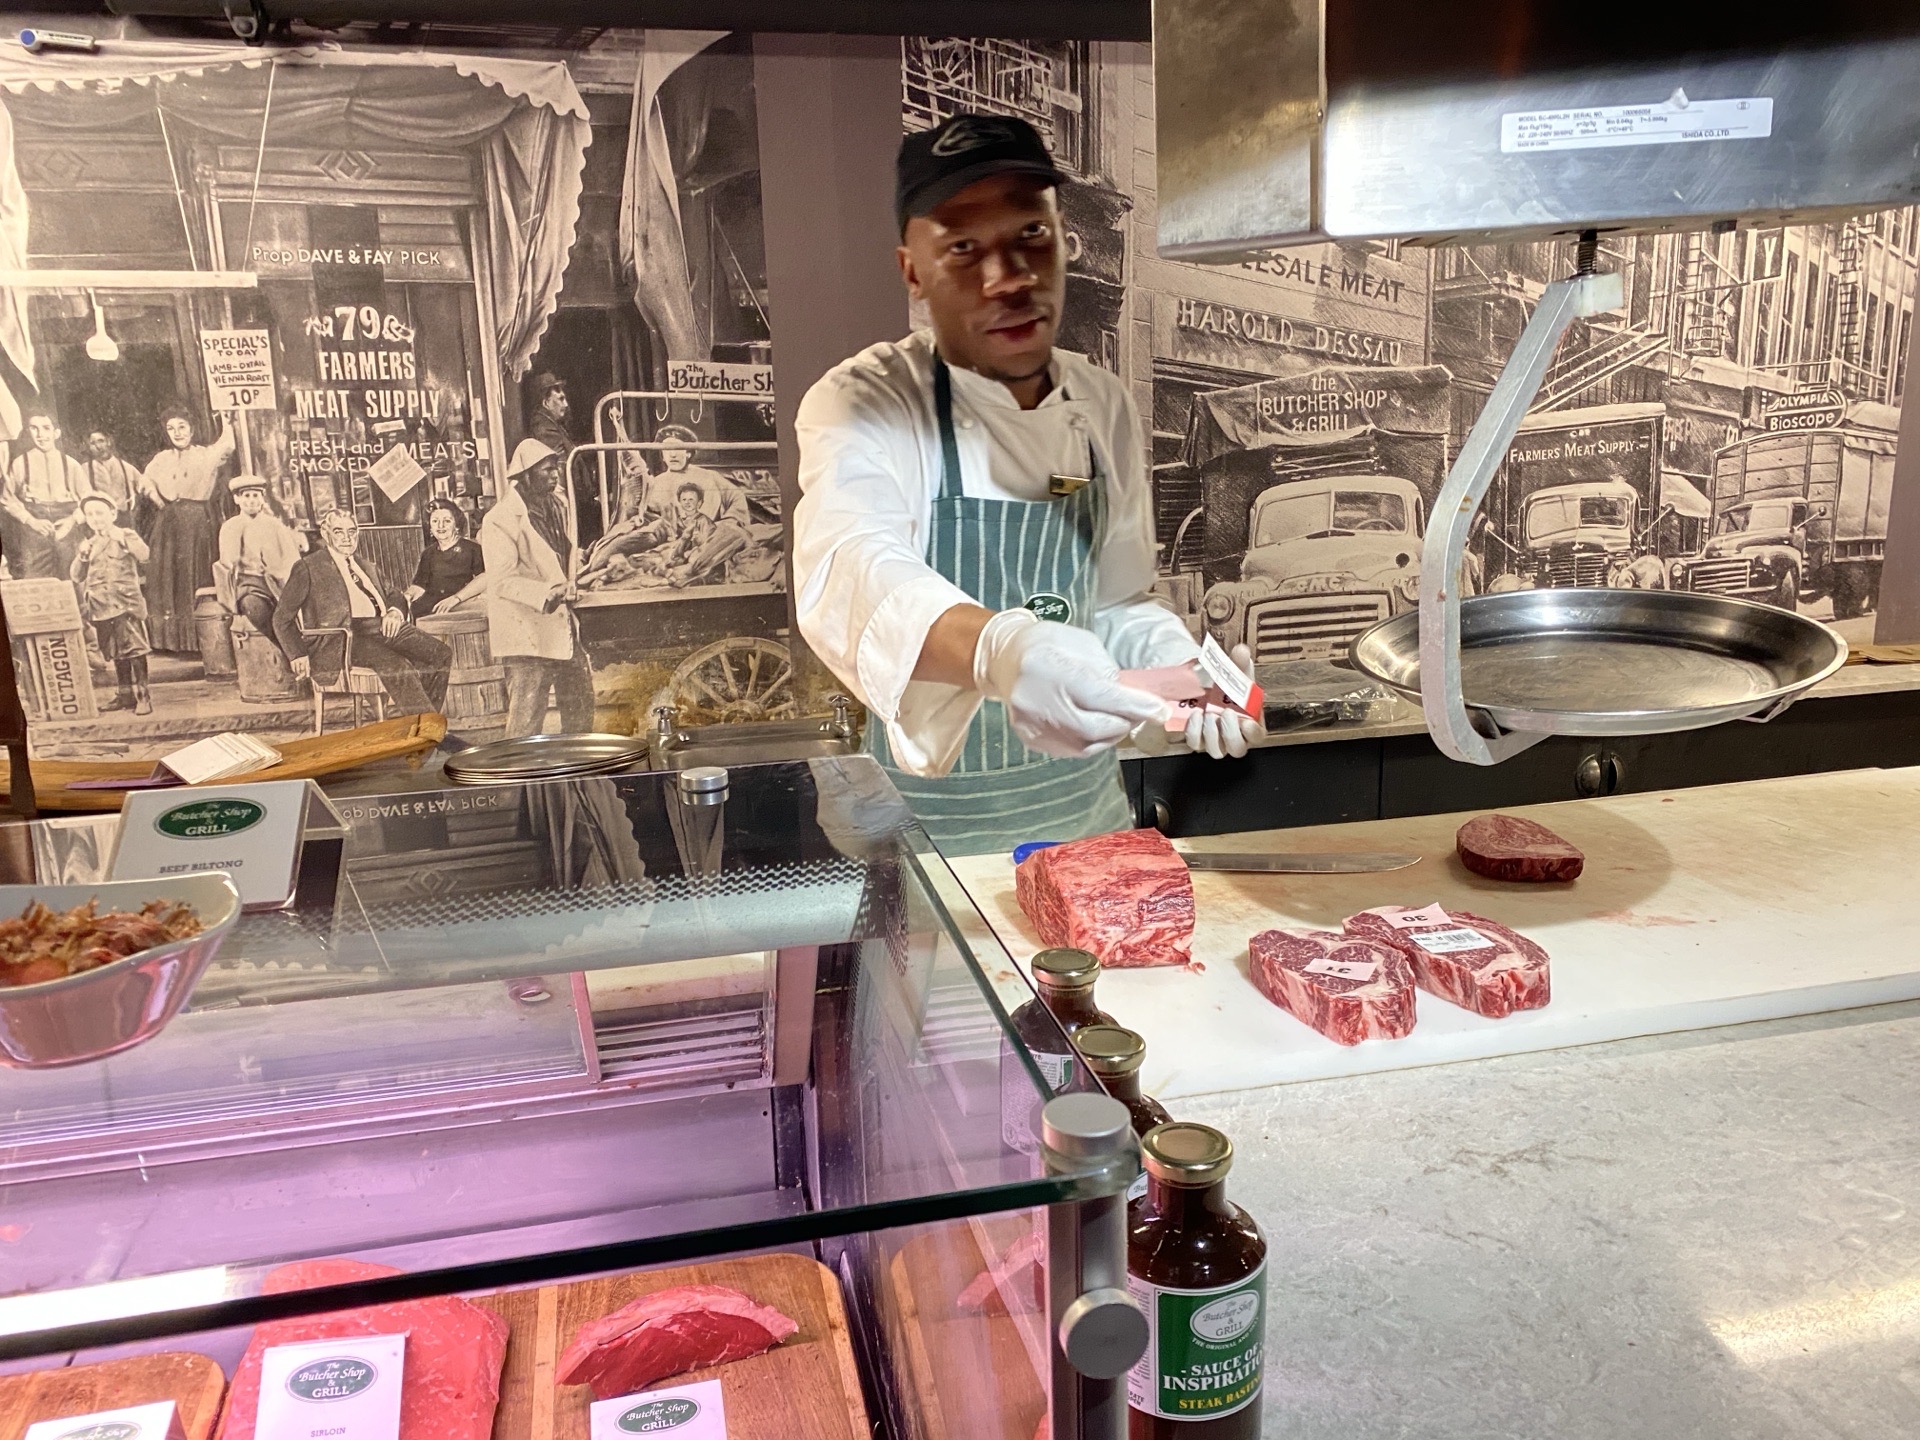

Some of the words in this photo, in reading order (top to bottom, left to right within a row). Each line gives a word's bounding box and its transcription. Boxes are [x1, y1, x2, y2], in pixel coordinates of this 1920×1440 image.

[1573, 111, 1592, 119] SERIAL
[1682, 130, 1703, 139] ISHIDA
[253, 248, 292, 265] Prop
[298, 249, 343, 263] DAVE
[348, 248, 361, 264] &
[364, 250, 393, 264] FAY
[401, 251, 440, 265] PICK
[1341, 267, 1405, 303] MEAT
[1178, 299, 1294, 345] HAROLD
[1314, 326, 1402, 366] DESSAU
[203, 335, 268, 350] SPECIAL'S
[319, 351, 416, 381] FARMERS
[686, 363, 703, 373] The
[670, 367, 750, 392] Butcher
[1311, 373, 1337, 391] the
[294, 389, 350, 419] MEAT
[365, 389, 441, 419] SUPPLY
[1261, 392, 1340, 416] BUTCHER
[1343, 389, 1388, 410] SHOP
[1779, 392, 1830, 408] OLYMPIA
[1291, 417, 1305, 435] &
[1769, 412, 1836, 431] Bioscope
[289, 439, 347, 457] FRESH
[350, 438, 385, 455] and
[400, 441, 477, 460] MEATS
[1509, 448, 1560, 463] FARMERS
[1564, 441, 1597, 458] MEAT
[289, 456, 372, 473] SMOKED
[49, 637, 78, 715] OCTAGON
[170, 810, 219, 822] Butcher
[220, 807, 253, 819] Shop
[184, 824, 231, 836] GRILL
[159, 863, 189, 874] BEEF
[191, 859, 244, 872] BILTONG
[1203, 1308, 1237, 1323] Butcher
[1215, 1321, 1244, 1337] GRILL
[1192, 1337, 1205, 1348] THE
[1205, 1341, 1237, 1350] ORIGINAL
[327, 1362, 340, 1372] The
[1190, 1354, 1243, 1377] SAUCE
[1244, 1342, 1259, 1362] OF
[298, 1370, 340, 1382] Butcher
[340, 1366, 367, 1381] Shop
[327, 1379, 336, 1387] &
[312, 1385, 350, 1398] GRILL
[651, 1402, 664, 1411] The
[1178, 1396, 1223, 1409] STEAK
[626, 1408, 665, 1421] Butcher
[665, 1403, 690, 1415] Shop
[310, 1427, 347, 1438] SIRLOIN
[641, 1418, 677, 1431] GRILL
